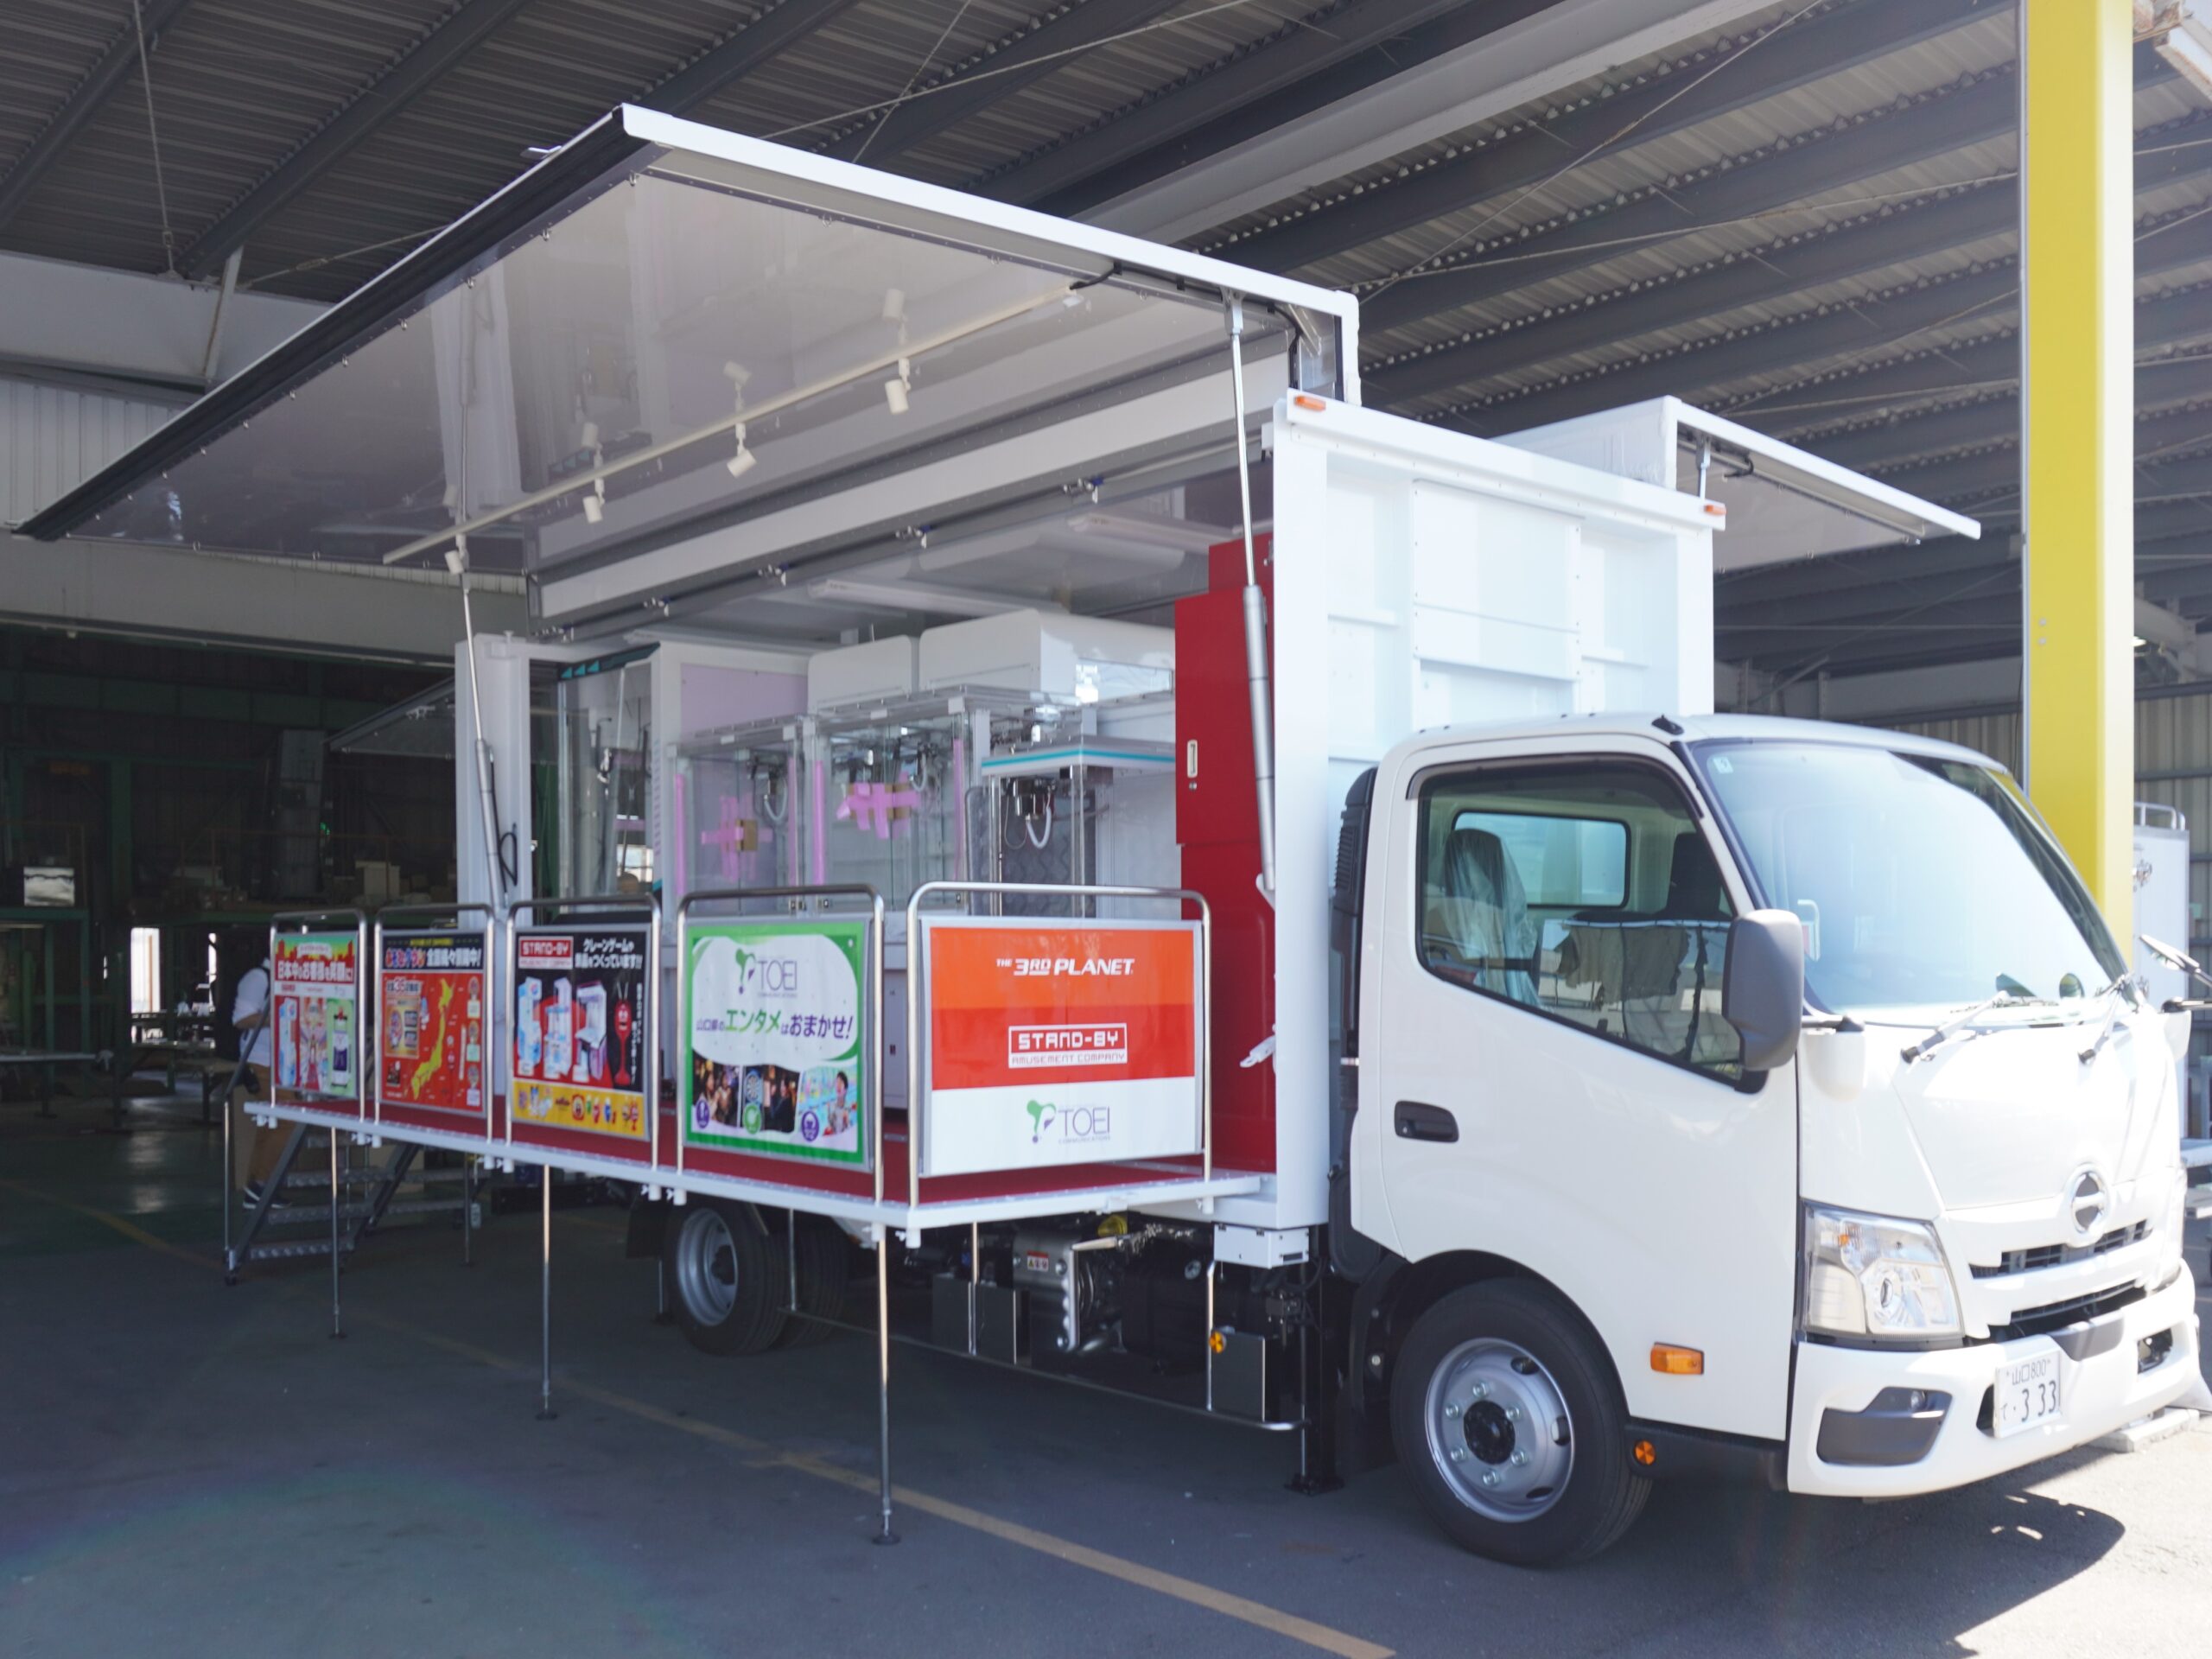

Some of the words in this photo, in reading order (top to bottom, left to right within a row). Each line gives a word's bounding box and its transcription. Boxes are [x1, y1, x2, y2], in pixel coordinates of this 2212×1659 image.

[523, 942, 569, 956] STAND-BY
[756, 959, 798, 991] TOEI
[996, 958, 1013, 967] THE
[1014, 958, 1052, 976] 3RD
[1053, 958, 1135, 976] PLANET
[1018, 1031, 1118, 1050] STAND-BY
[1011, 1053, 1075, 1065] AMUSEMENT
[1077, 1051, 1125, 1064] COMPANY
[1057, 1106, 1110, 1137] TOEI
[2012, 1364, 2031, 1385] 山口
[2031, 1359, 2047, 1380] 800
